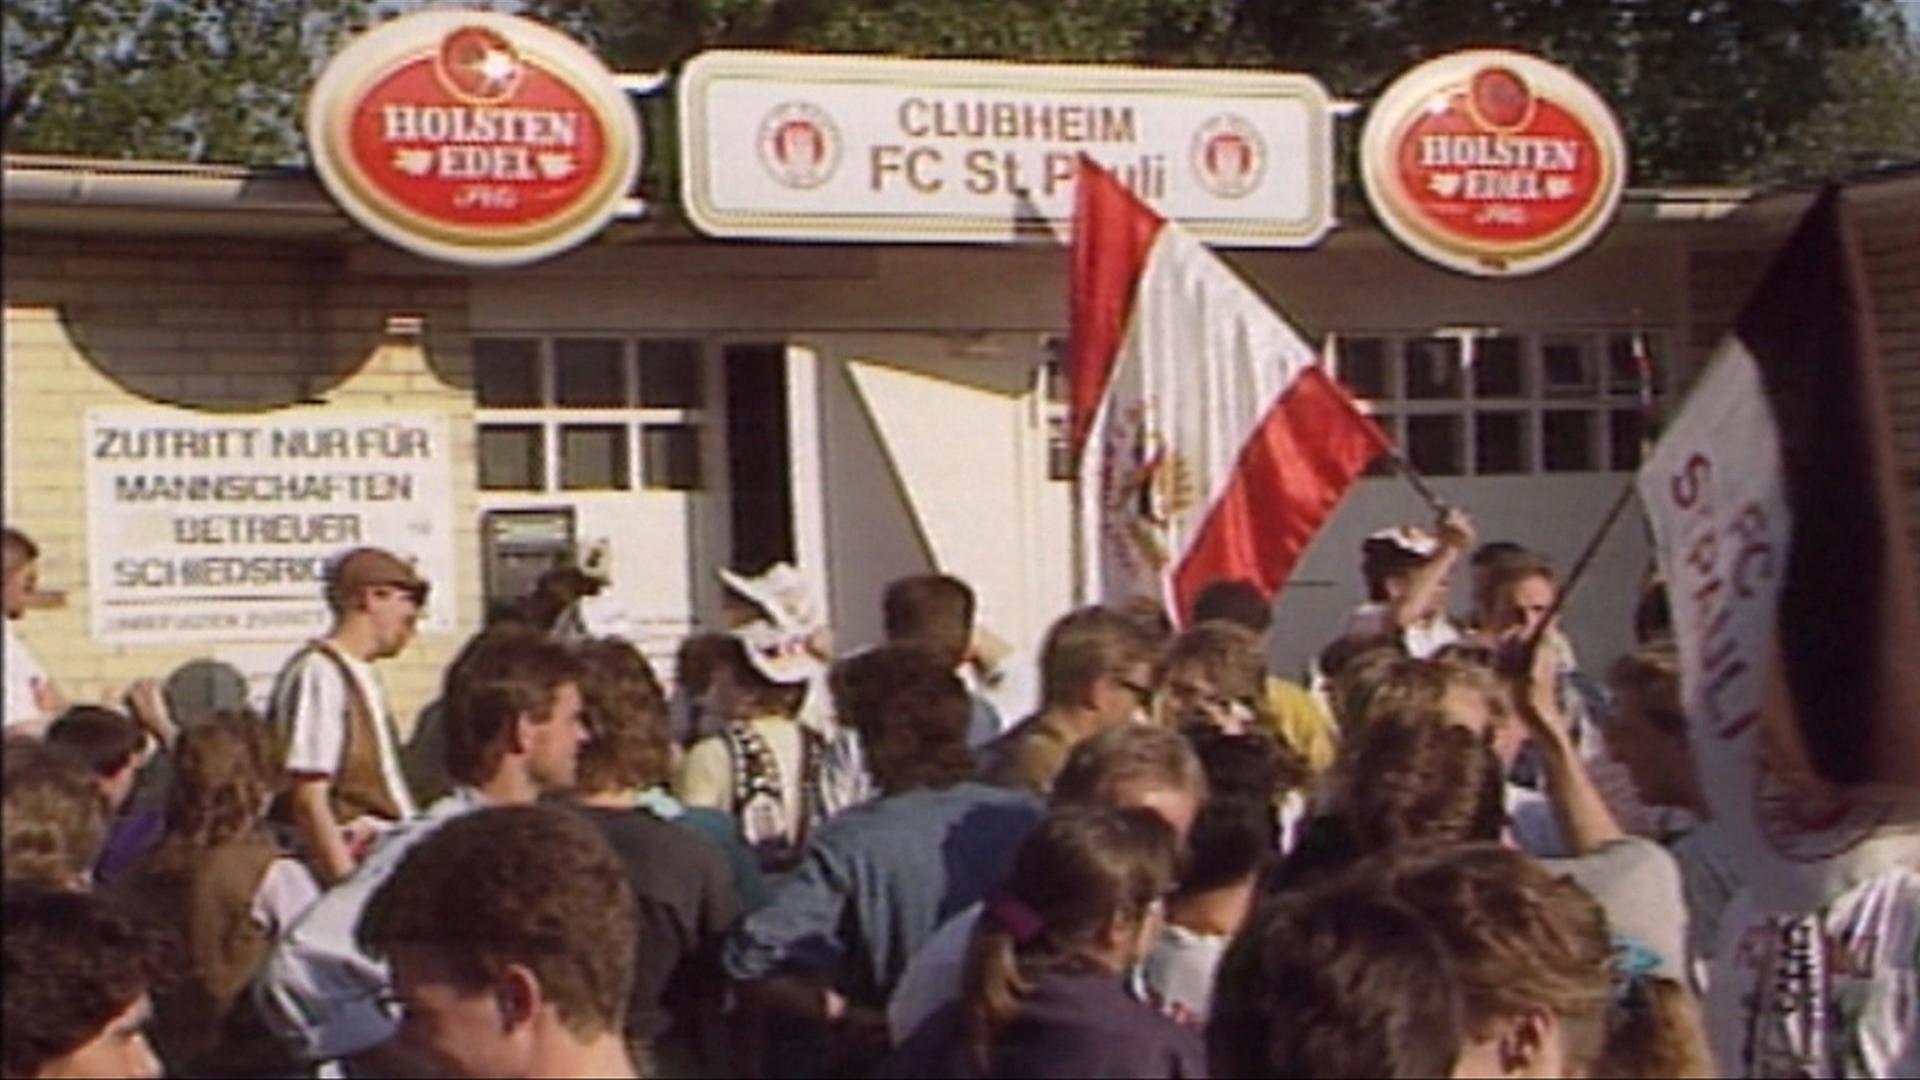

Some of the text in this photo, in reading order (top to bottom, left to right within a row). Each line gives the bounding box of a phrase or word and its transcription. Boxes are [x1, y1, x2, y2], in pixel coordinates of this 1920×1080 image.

[382, 103, 578, 146] HOLSTEN
[898, 97, 1136, 142] CLUBHEIM
[436, 146, 536, 180] EDEL
[868, 145, 943, 193] FC
[1420, 135, 1579, 171] HOLSTEN
[1462, 170, 1540, 199] EDEL
[94, 422, 431, 459] ZUTRITT NUR FÜR
[113, 472, 414, 502] MANNSCHAFTEN
[173, 512, 363, 545] BETREUER
[113, 556, 340, 588] SCHIEDSRIC
